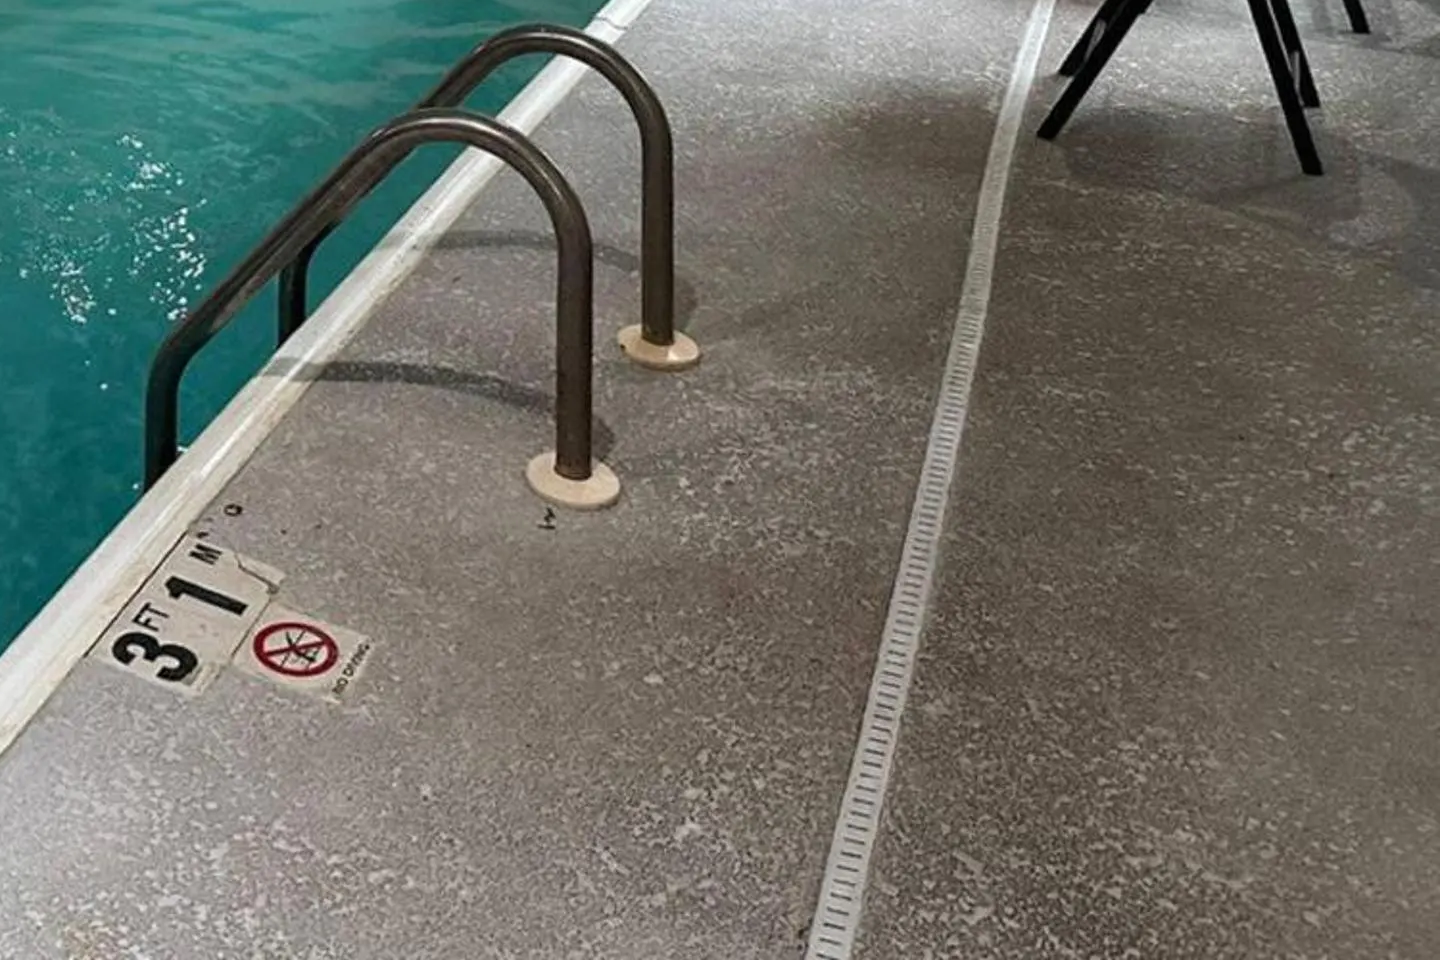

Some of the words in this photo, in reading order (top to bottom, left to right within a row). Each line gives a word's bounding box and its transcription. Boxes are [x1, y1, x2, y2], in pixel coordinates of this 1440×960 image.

[188, 542, 223, 565] M
[164, 576, 248, 616] 1
[132, 602, 169, 632] FT
[111, 631, 198, 682] 3
